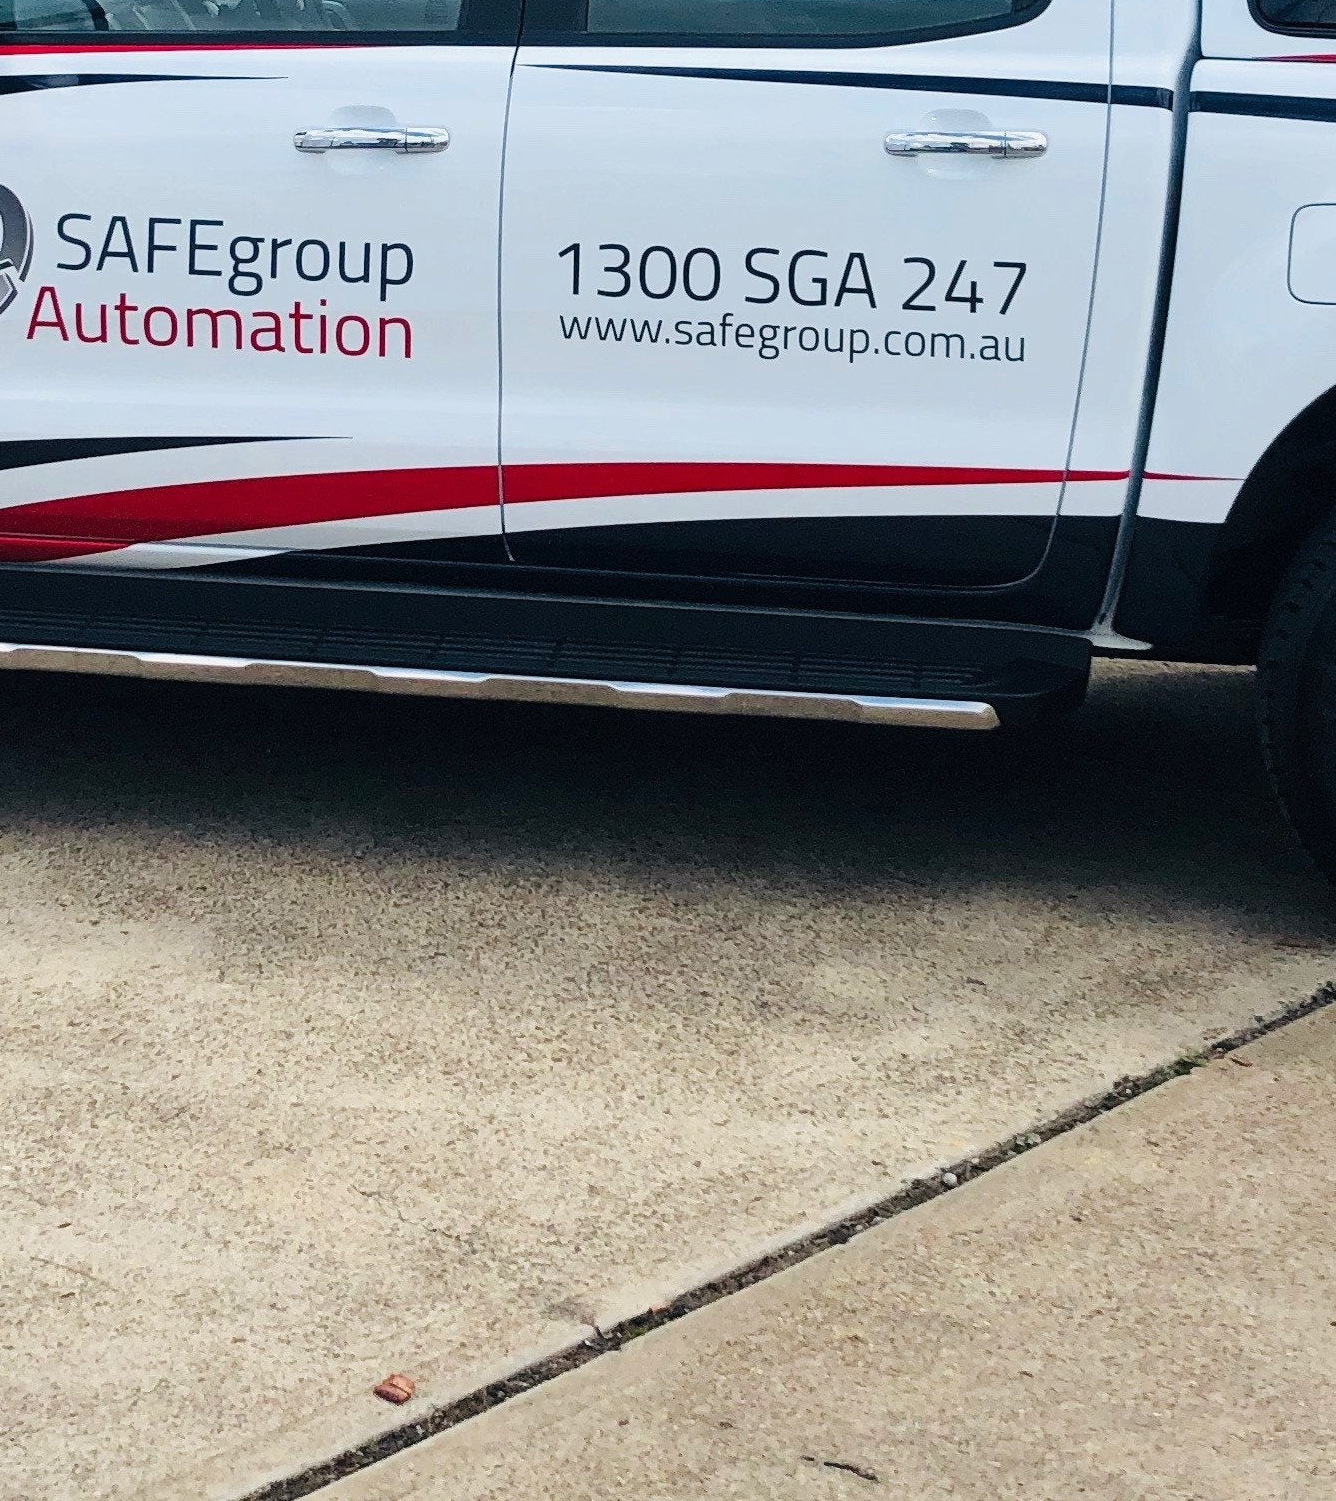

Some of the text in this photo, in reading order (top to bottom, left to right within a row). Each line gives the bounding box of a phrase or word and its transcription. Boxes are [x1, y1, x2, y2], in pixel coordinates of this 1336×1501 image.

[55, 212, 414, 302] SAFEgroup
[557, 242, 1028, 316] 1300 SGA 247
[26, 286, 413, 359] Automation
[559, 312, 1026, 363] www.safegroup.com.au
